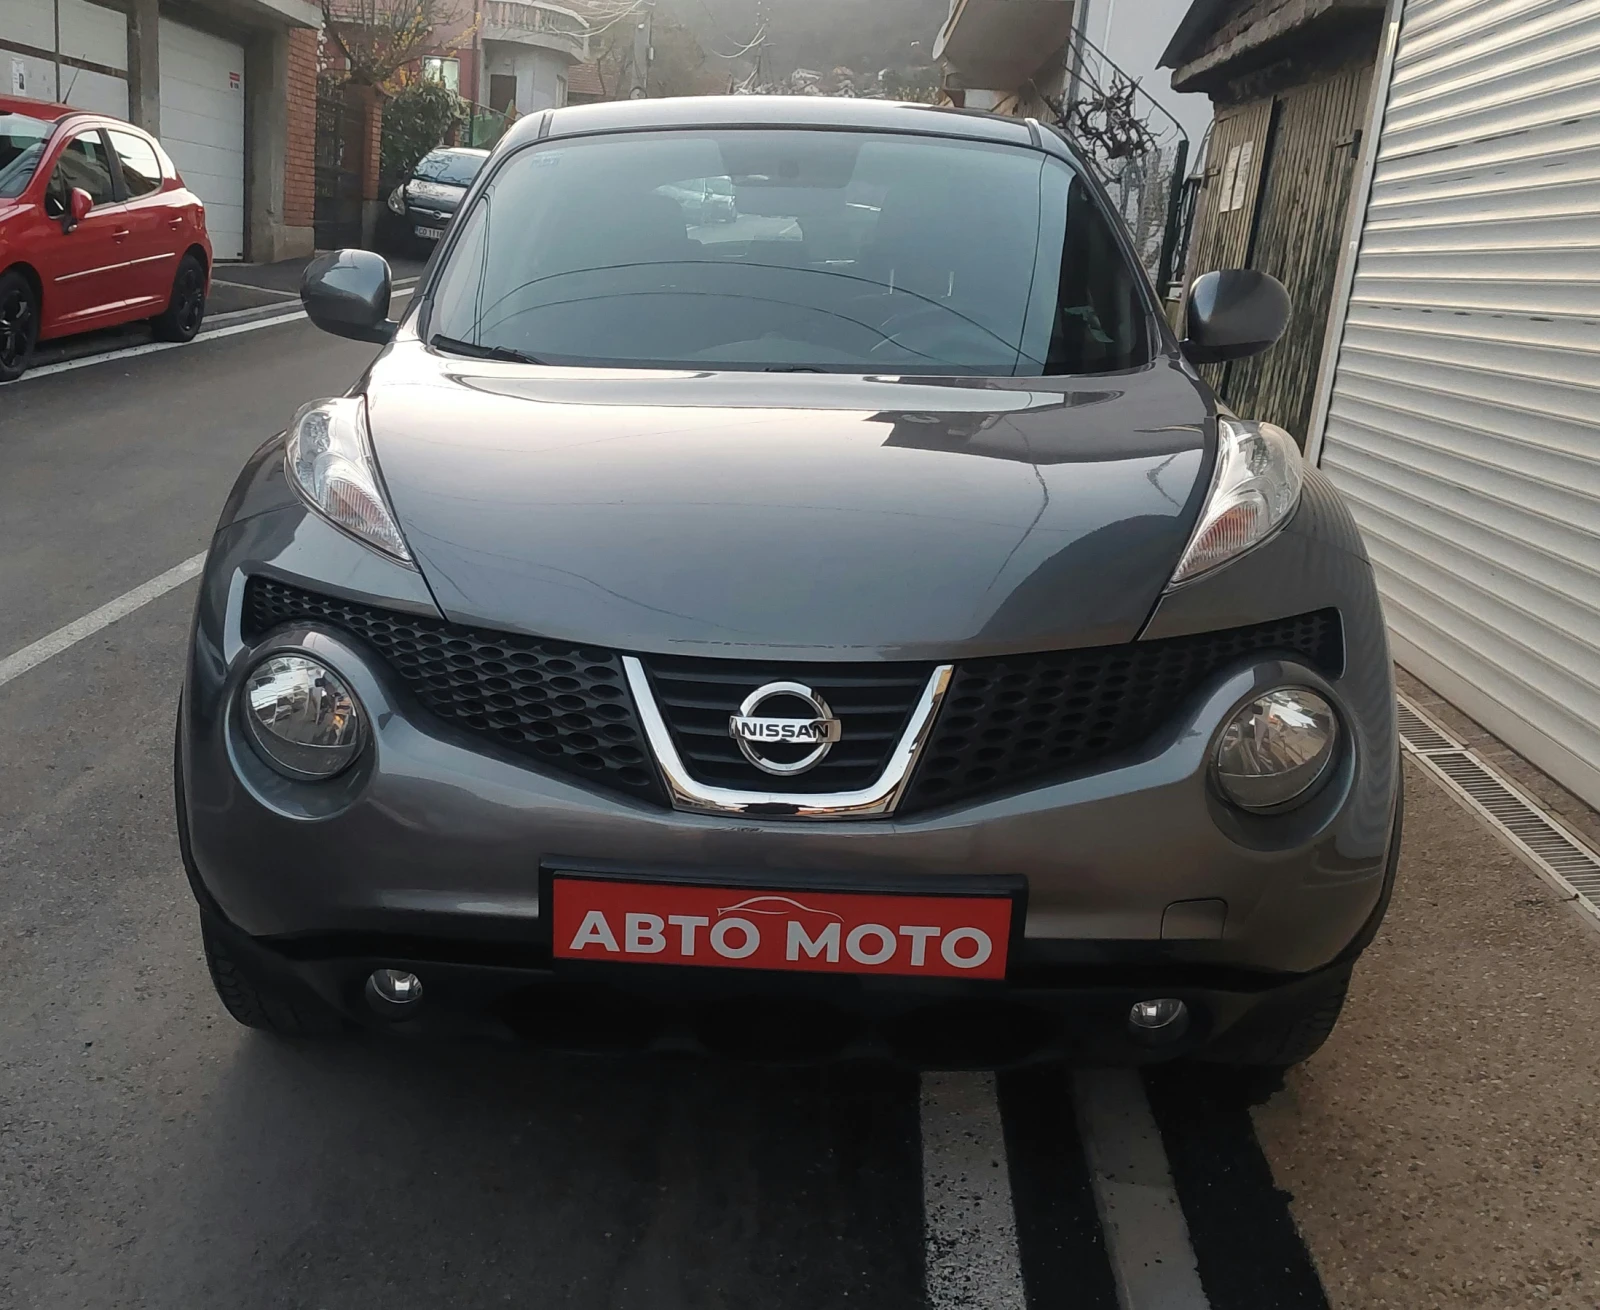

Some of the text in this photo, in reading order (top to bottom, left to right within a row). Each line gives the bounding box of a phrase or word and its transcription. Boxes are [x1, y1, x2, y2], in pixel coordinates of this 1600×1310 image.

[741, 722, 829, 738] NISSAN
[569, 910, 993, 969] АВТО МОТО
